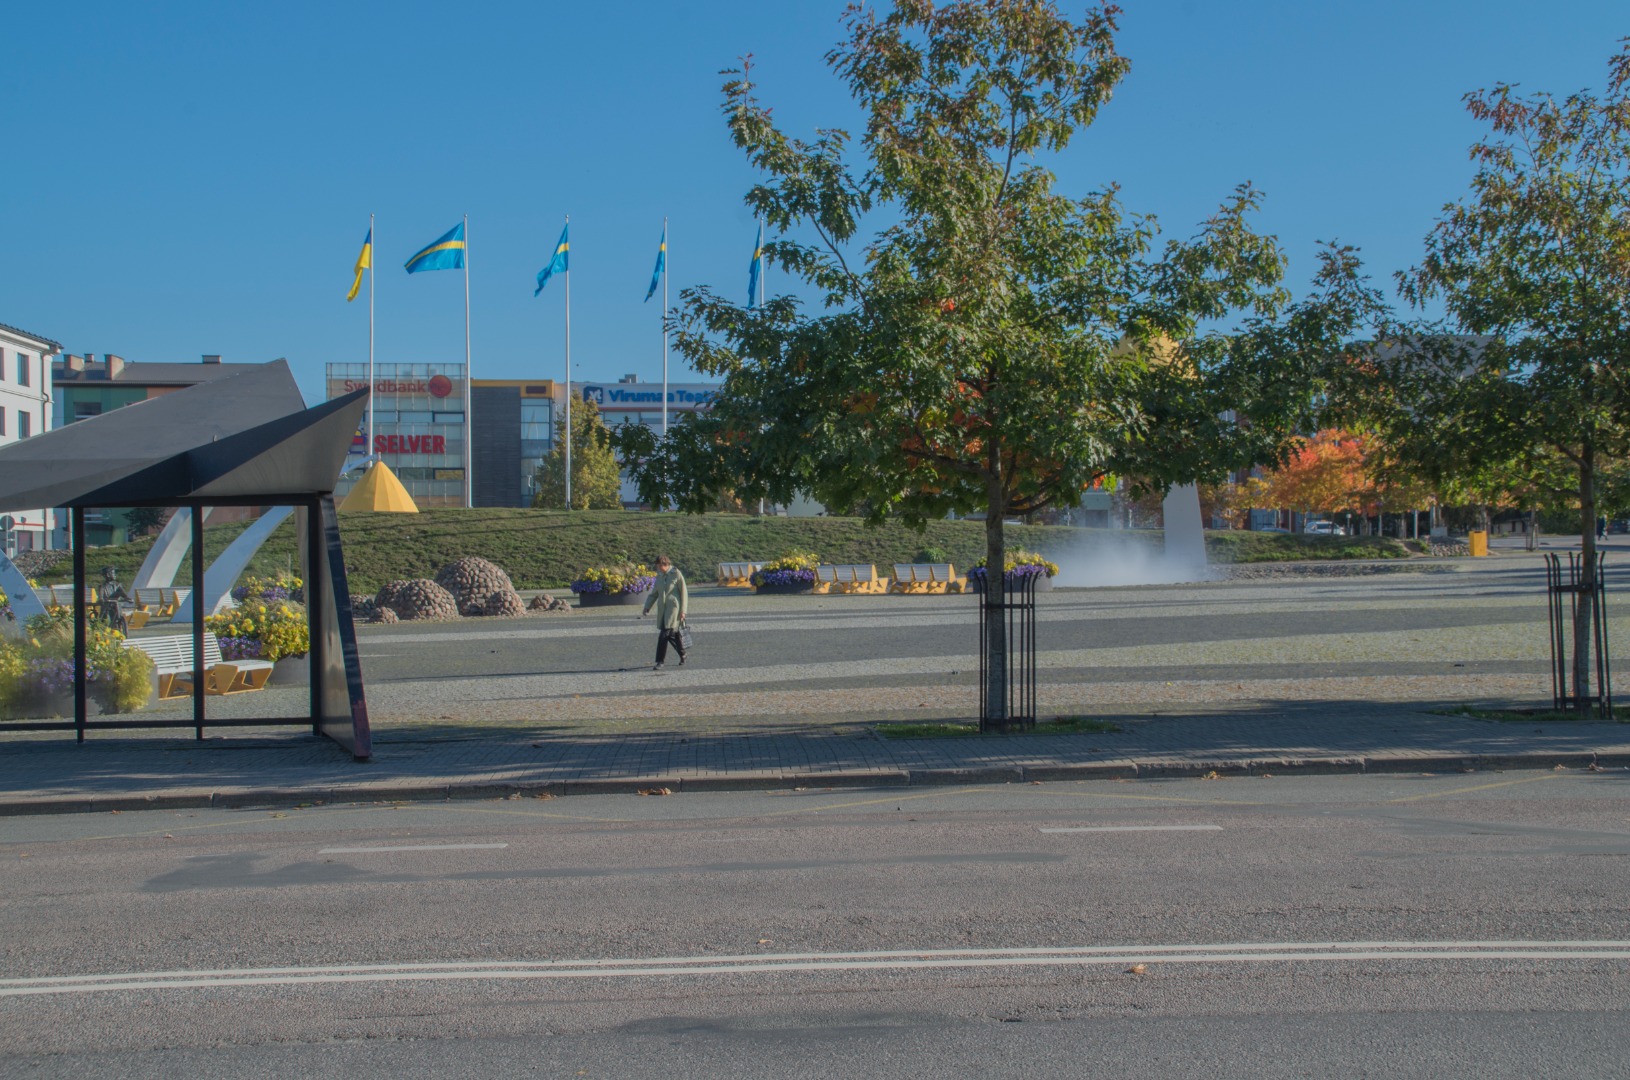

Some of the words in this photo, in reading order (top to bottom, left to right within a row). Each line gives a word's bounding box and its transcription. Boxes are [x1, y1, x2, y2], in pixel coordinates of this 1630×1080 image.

[344, 379, 426, 393] Swdbank
[608, 389, 674, 402] Virumaa
[374, 434, 445, 454] SELVER
